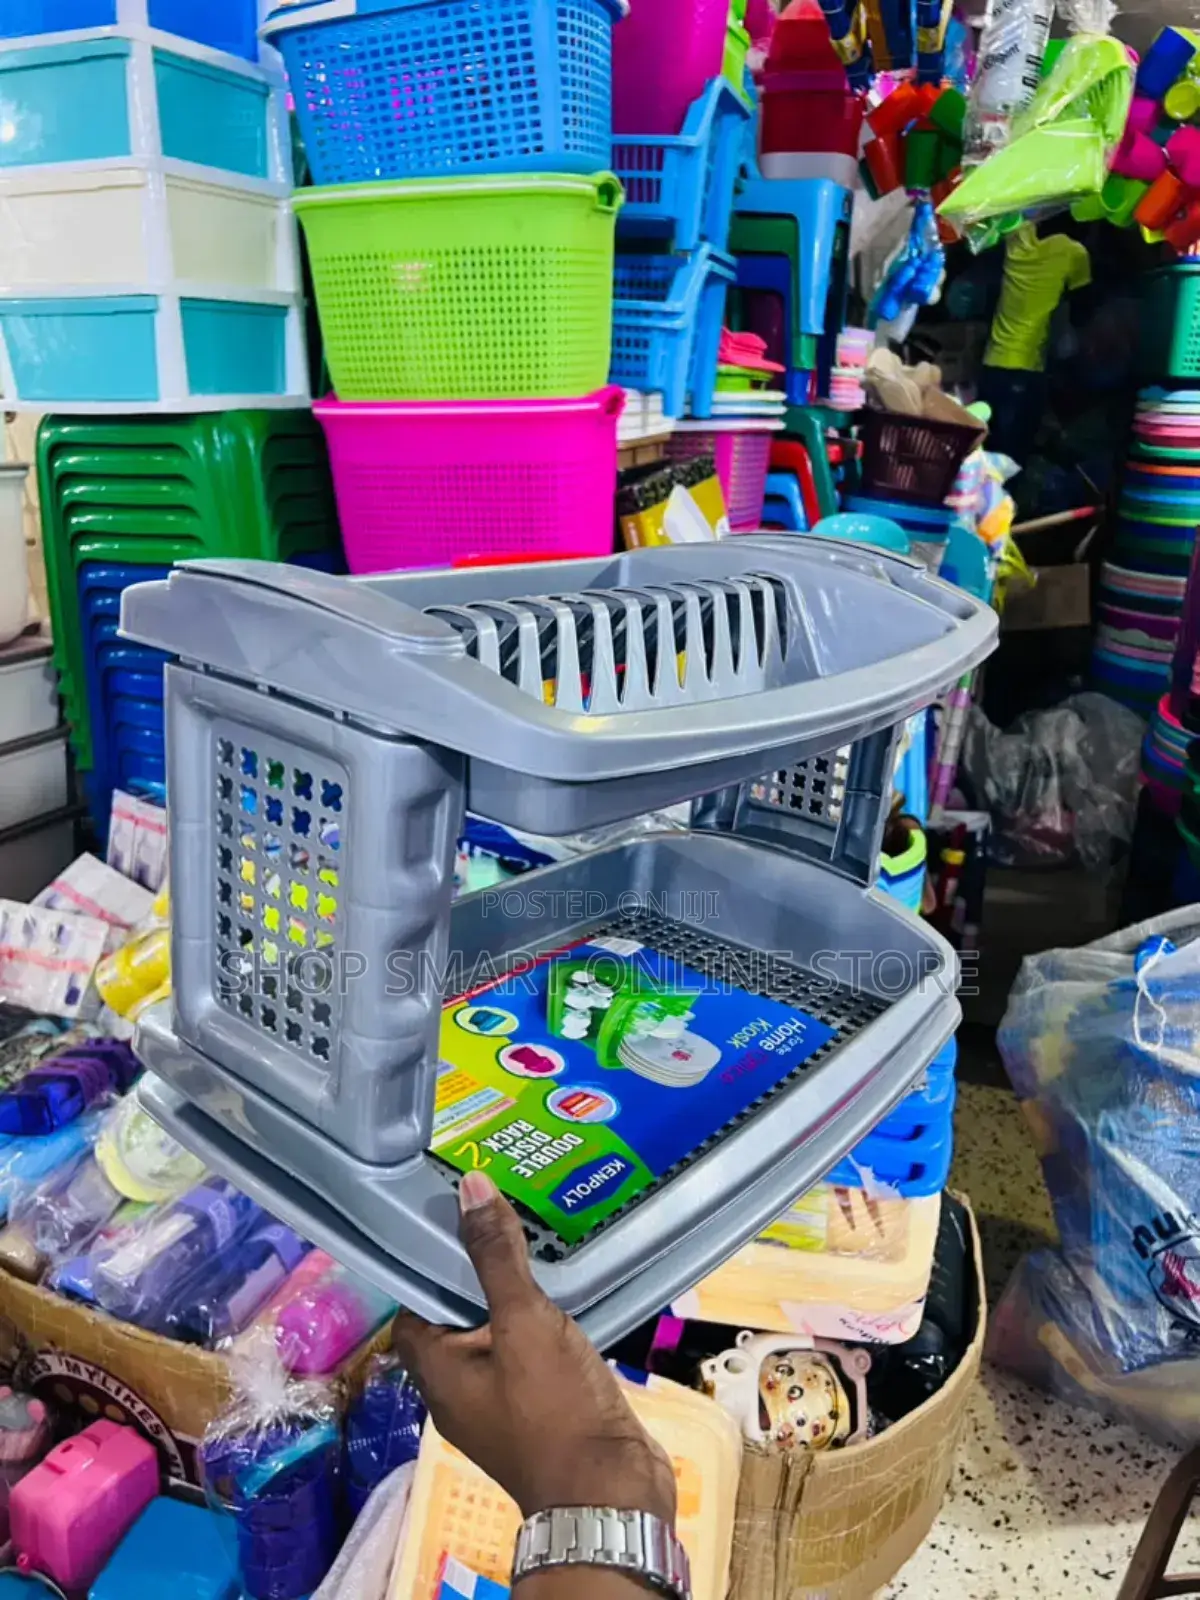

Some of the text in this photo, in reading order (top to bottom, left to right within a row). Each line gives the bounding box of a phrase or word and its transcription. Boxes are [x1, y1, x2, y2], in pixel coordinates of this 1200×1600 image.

[726, 1016, 773, 1049] Kiosk
[759, 1016, 807, 1052] Home
[453, 1119, 536, 1169] RACK 2
[503, 1127, 554, 1161] DISH
[510, 1131, 585, 1179] DOUBLE
[561, 1158, 626, 1209] KENPOLY
